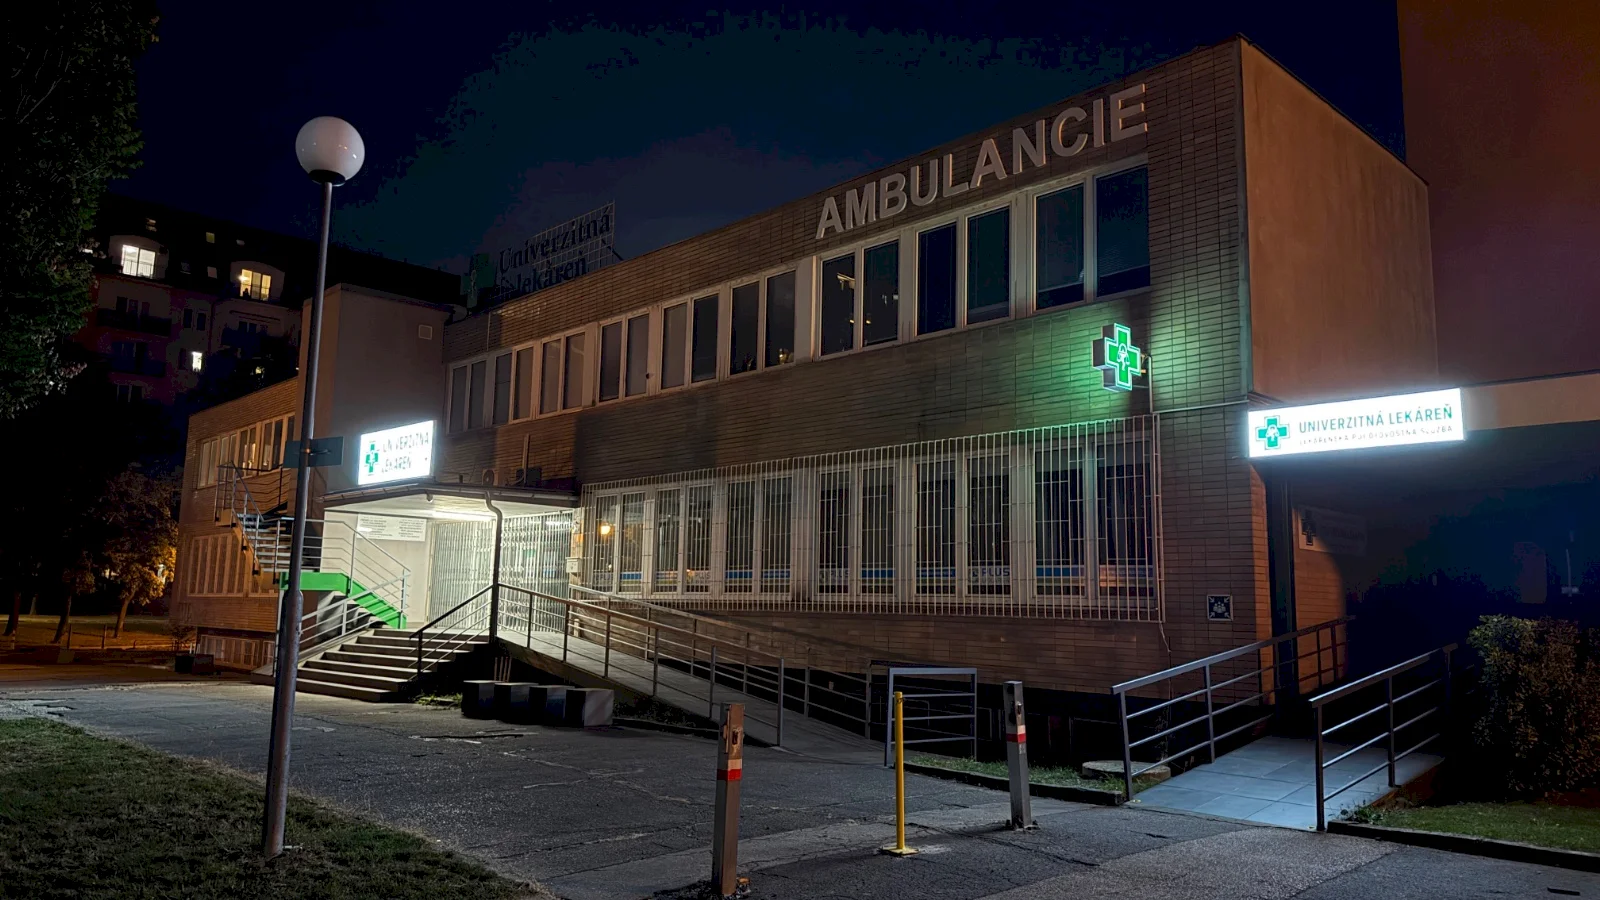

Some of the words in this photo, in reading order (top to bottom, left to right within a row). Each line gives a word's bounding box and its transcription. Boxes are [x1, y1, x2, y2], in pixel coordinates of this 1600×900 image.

[816, 83, 1148, 240] AMBULANCIE
[500, 206, 610, 274] Univerzitná
[1299, 410, 1385, 434] UNIVERZITNÁ
[1388, 403, 1453, 425] LEKÁREŇ
